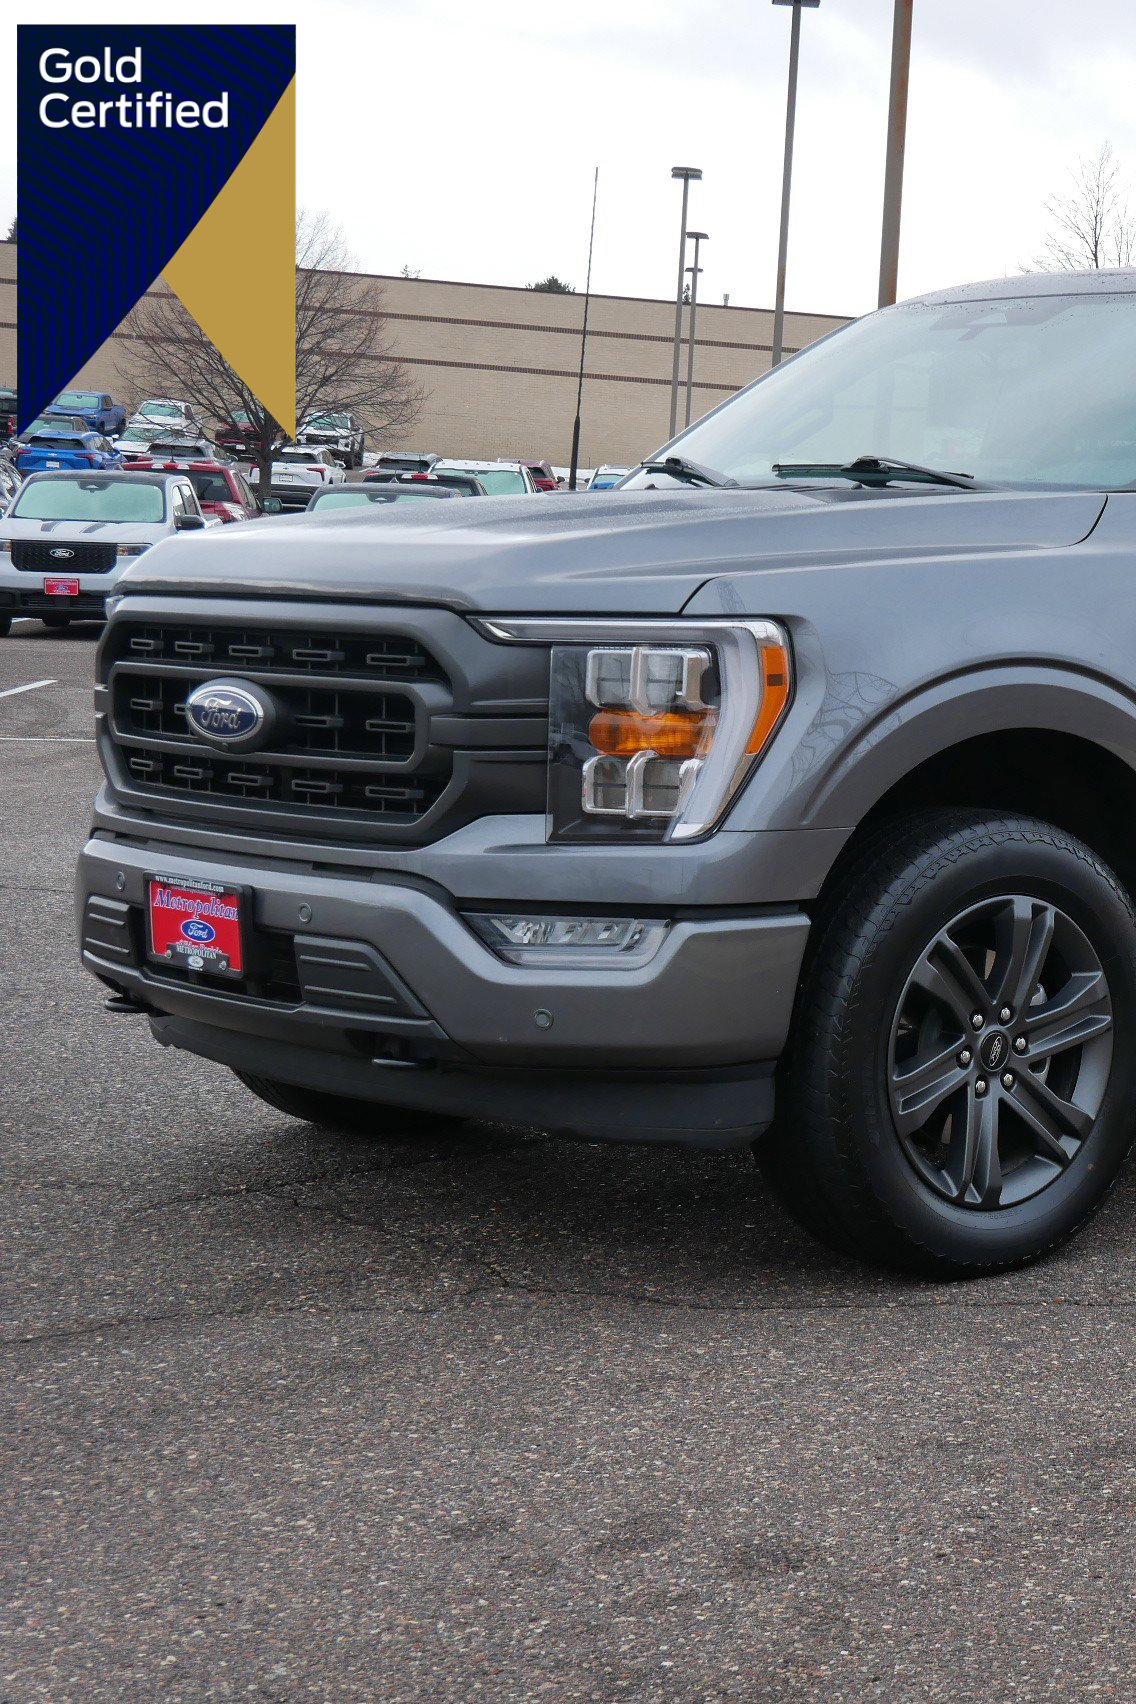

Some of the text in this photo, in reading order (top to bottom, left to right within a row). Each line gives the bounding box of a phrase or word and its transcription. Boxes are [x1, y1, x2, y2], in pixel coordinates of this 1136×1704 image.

[201, 697, 241, 729] Ford
[154, 888, 239, 921] Metropolitan
[187, 922, 208, 938] Ford
